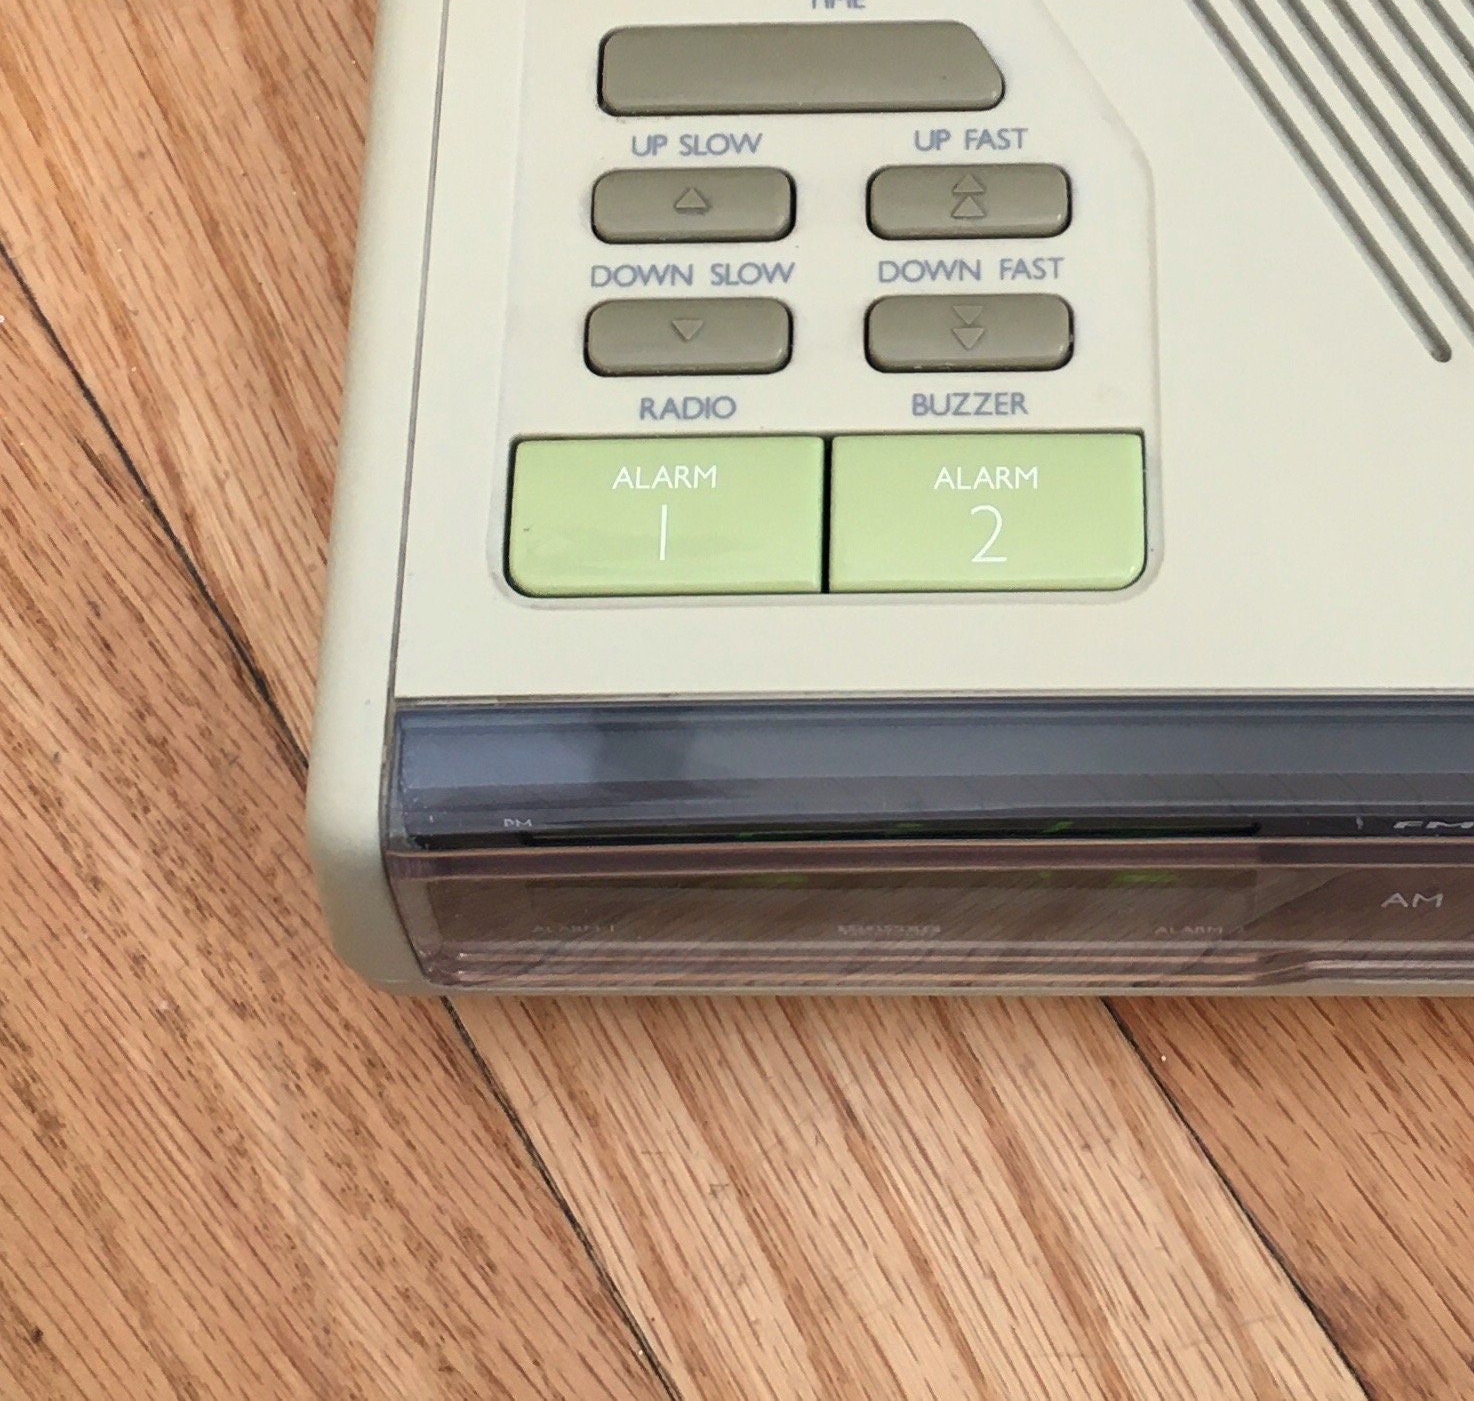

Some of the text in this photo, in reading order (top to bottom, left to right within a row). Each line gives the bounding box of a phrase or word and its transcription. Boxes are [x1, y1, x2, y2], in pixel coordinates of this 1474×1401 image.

[631, 132, 763, 156] UP SLOW
[914, 127, 1028, 151] UP FAST
[590, 261, 796, 287] DOWN SLOW
[878, 257, 1066, 282] DOWN FAST
[639, 397, 736, 420] RADIO
[911, 393, 1028, 417] BUZZER
[612, 465, 718, 490] ALARM
[933, 466, 1039, 490] ALARM
[658, 504, 668, 561] 1
[969, 504, 1008, 563] 2
[1394, 820, 1474, 830] FM
[1381, 892, 1443, 908] AM
